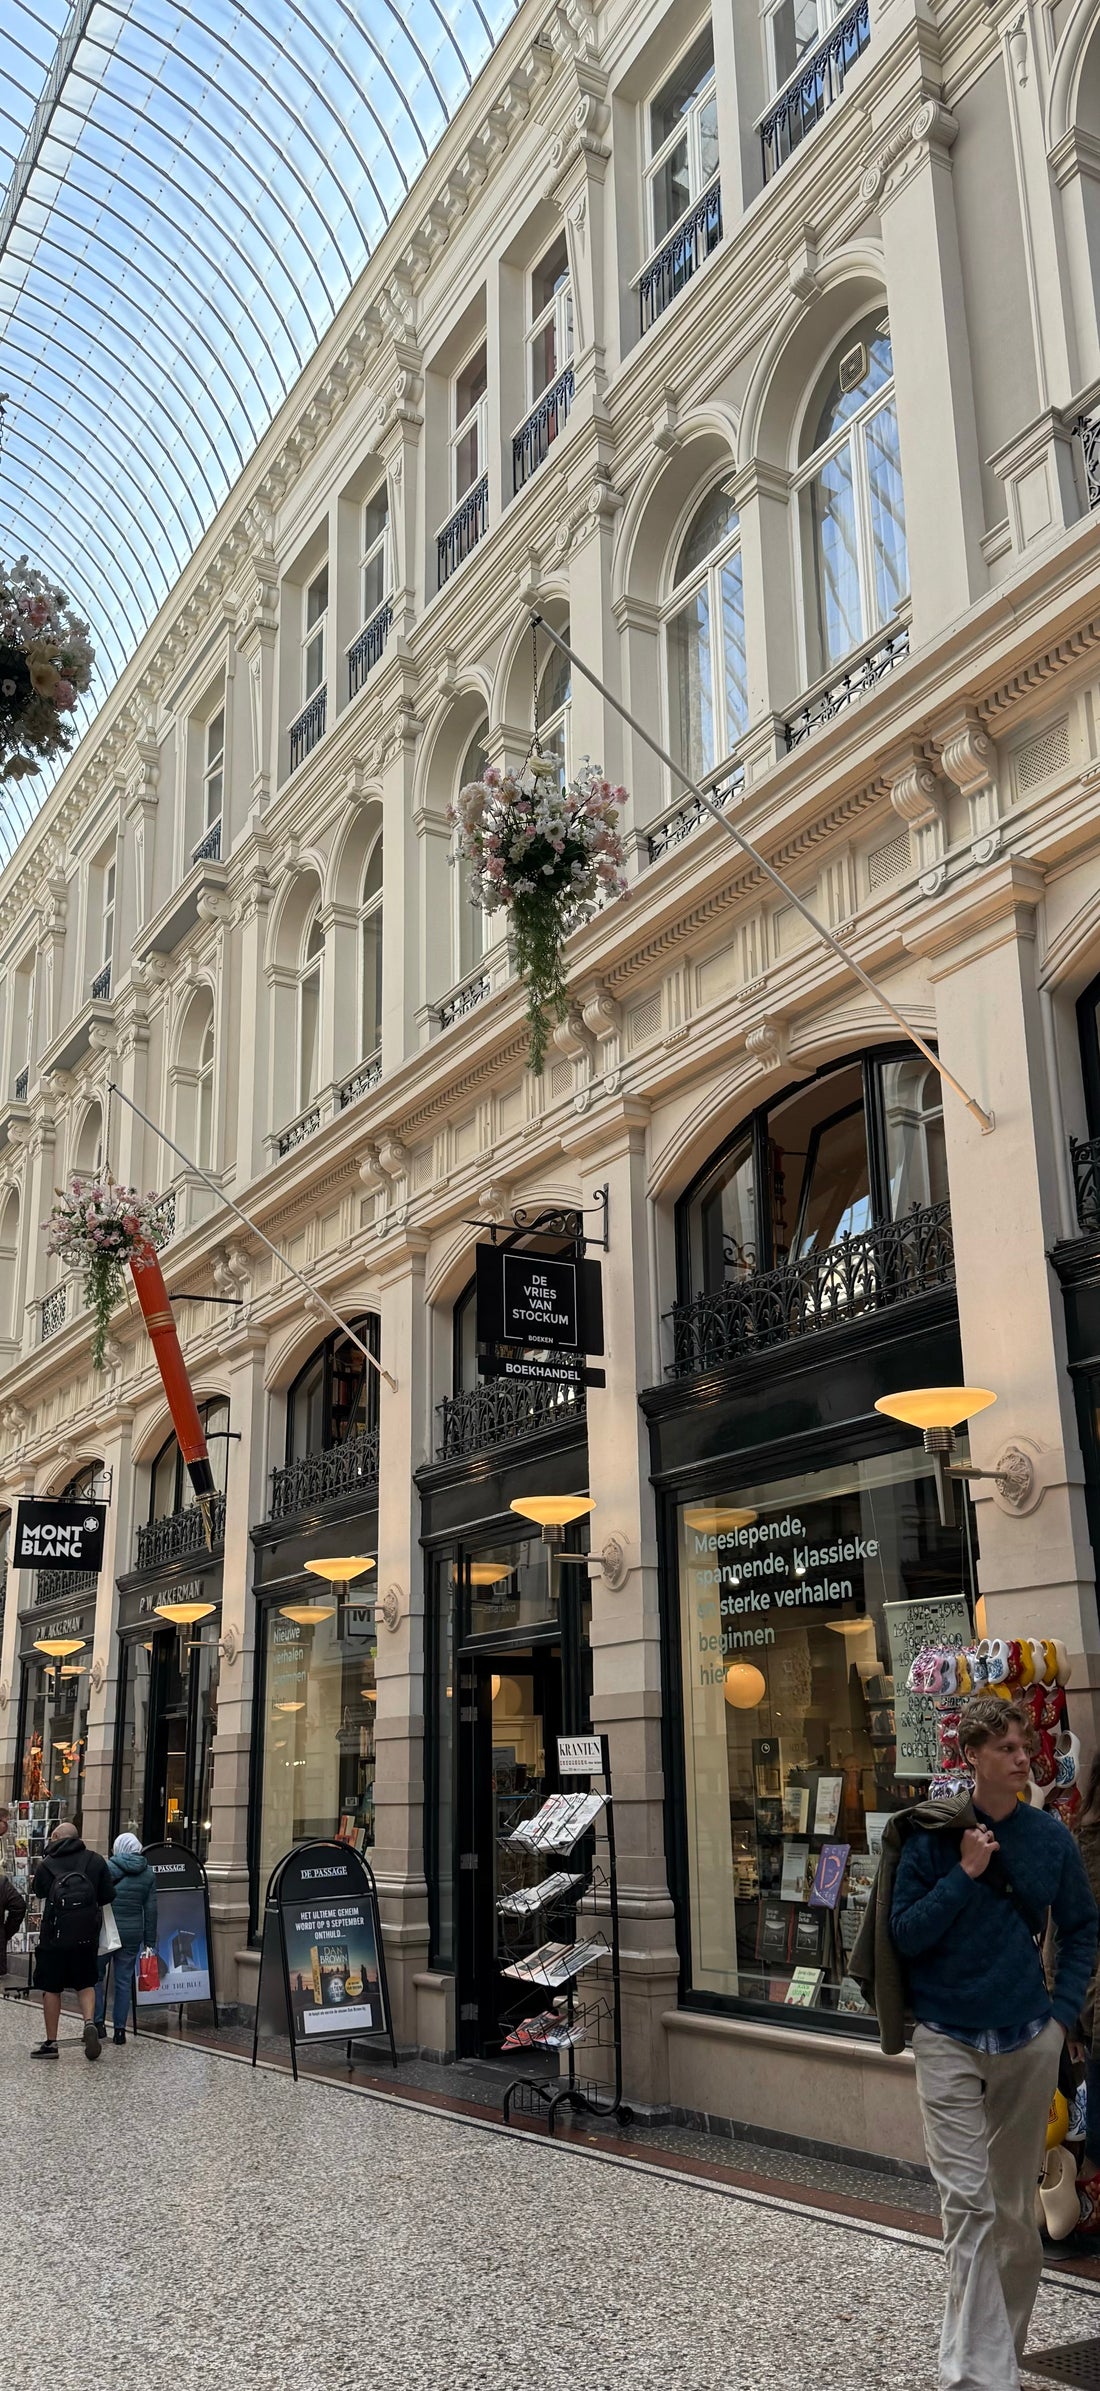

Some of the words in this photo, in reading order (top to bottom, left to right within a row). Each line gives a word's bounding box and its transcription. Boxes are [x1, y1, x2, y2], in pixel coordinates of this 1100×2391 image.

[532, 1275, 547, 1286] DE
[523, 1286, 557, 1299] VRIES
[529, 1299, 552, 1311] VAN
[512, 1309, 569, 1325] STOCKUM
[528, 1335, 554, 1344] BOEKEN
[505, 1363, 581, 1381] BOEKHANDEL
[22, 1523, 84, 1541] MONT
[694, 1515, 807, 1554] Meeslepende,
[20, 1540, 83, 1558] BLANC
[793, 1536, 879, 1571] klassieke
[695, 1552, 790, 1588] spannende,
[156, 1579, 201, 1607] AKKERMAN
[720, 1590, 771, 1616] sterke
[774, 1578, 853, 1608] verhalen
[48, 1615, 81, 1639] AKKERMAN
[274, 1627, 300, 1644] Nieuwe
[698, 1626, 776, 1655] beginnen
[559, 1742, 600, 1756] KRANTEN
[158, 1864, 186, 1873] PASSAGE
[301, 1869, 313, 1879] DE
[314, 1866, 348, 1878] PASSAGE
[300, 1911, 311, 1920] HET
[312, 1909, 337, 1919] ULTIEME
[337, 1907, 360, 1917] GEHEIM
[295, 1921, 316, 1931] WORDT
[317, 1920, 325, 1929] OP
[326, 1920, 331, 1928] 9
[331, 1916, 365, 1928] SEPTEMBER
[323, 1946, 343, 1956] DAN
[320, 1954, 348, 1965] BROWN
